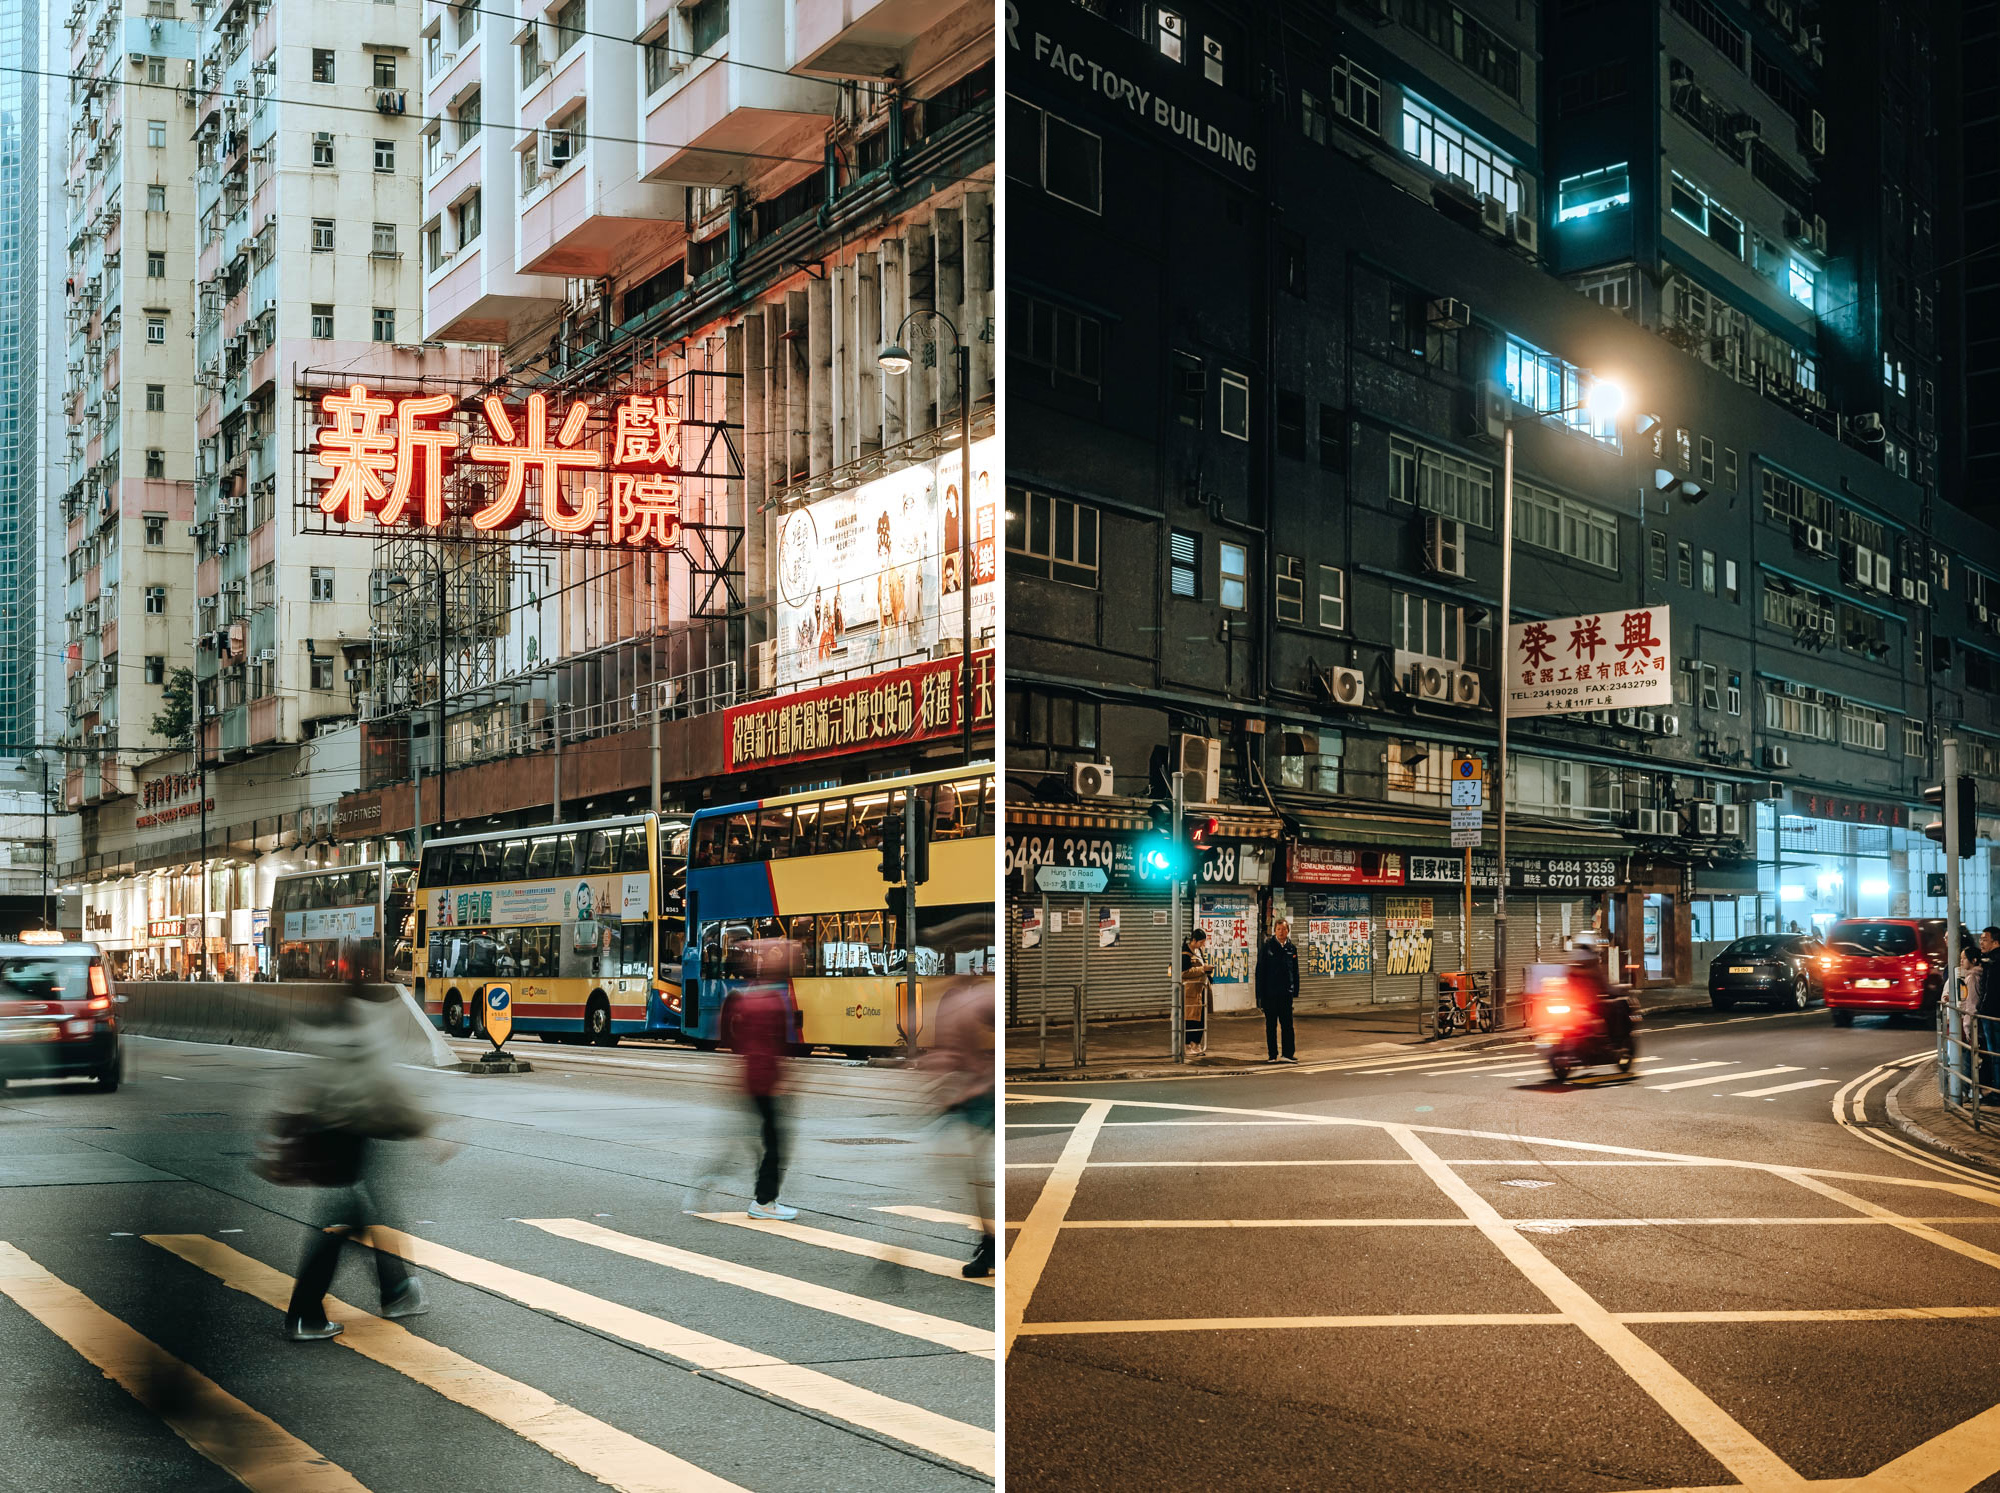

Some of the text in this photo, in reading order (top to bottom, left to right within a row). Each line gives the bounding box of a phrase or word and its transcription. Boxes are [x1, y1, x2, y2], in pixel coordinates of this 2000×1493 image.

[1034, 31, 1151, 117] FACTORY
[1154, 96, 1257, 173] BUILDING
[1518, 610, 1661, 669] 榮祥興
[1521, 656, 1666, 686] 電器工程有限公司
[1511, 679, 1658, 700] TEL:23419028 FAX:23432799
[732, 679, 913, 764] 祝賀新光戲院圓滿完成歷史使命
[919, 669, 952, 730] 特選
[1471, 781, 1476, 790] 7
[1471, 795, 1476, 803] 7
[339, 804, 381, 825] 24/7 FITNESS
[1051, 868, 1067, 878] Hung
[1078, 869, 1094, 877] Road
[1301, 862, 1356, 872] CENTALINE COMMERCIAL
[1413, 858, 1461, 879] 獨家代理
[1548, 860, 1615, 874] 6484 3359
[1548, 874, 1616, 887] 6701 7638
[1318, 958, 1344, 973] 9013
[1346, 956, 1370, 971] 3461
[862, 1006, 881, 1017] Citybus
